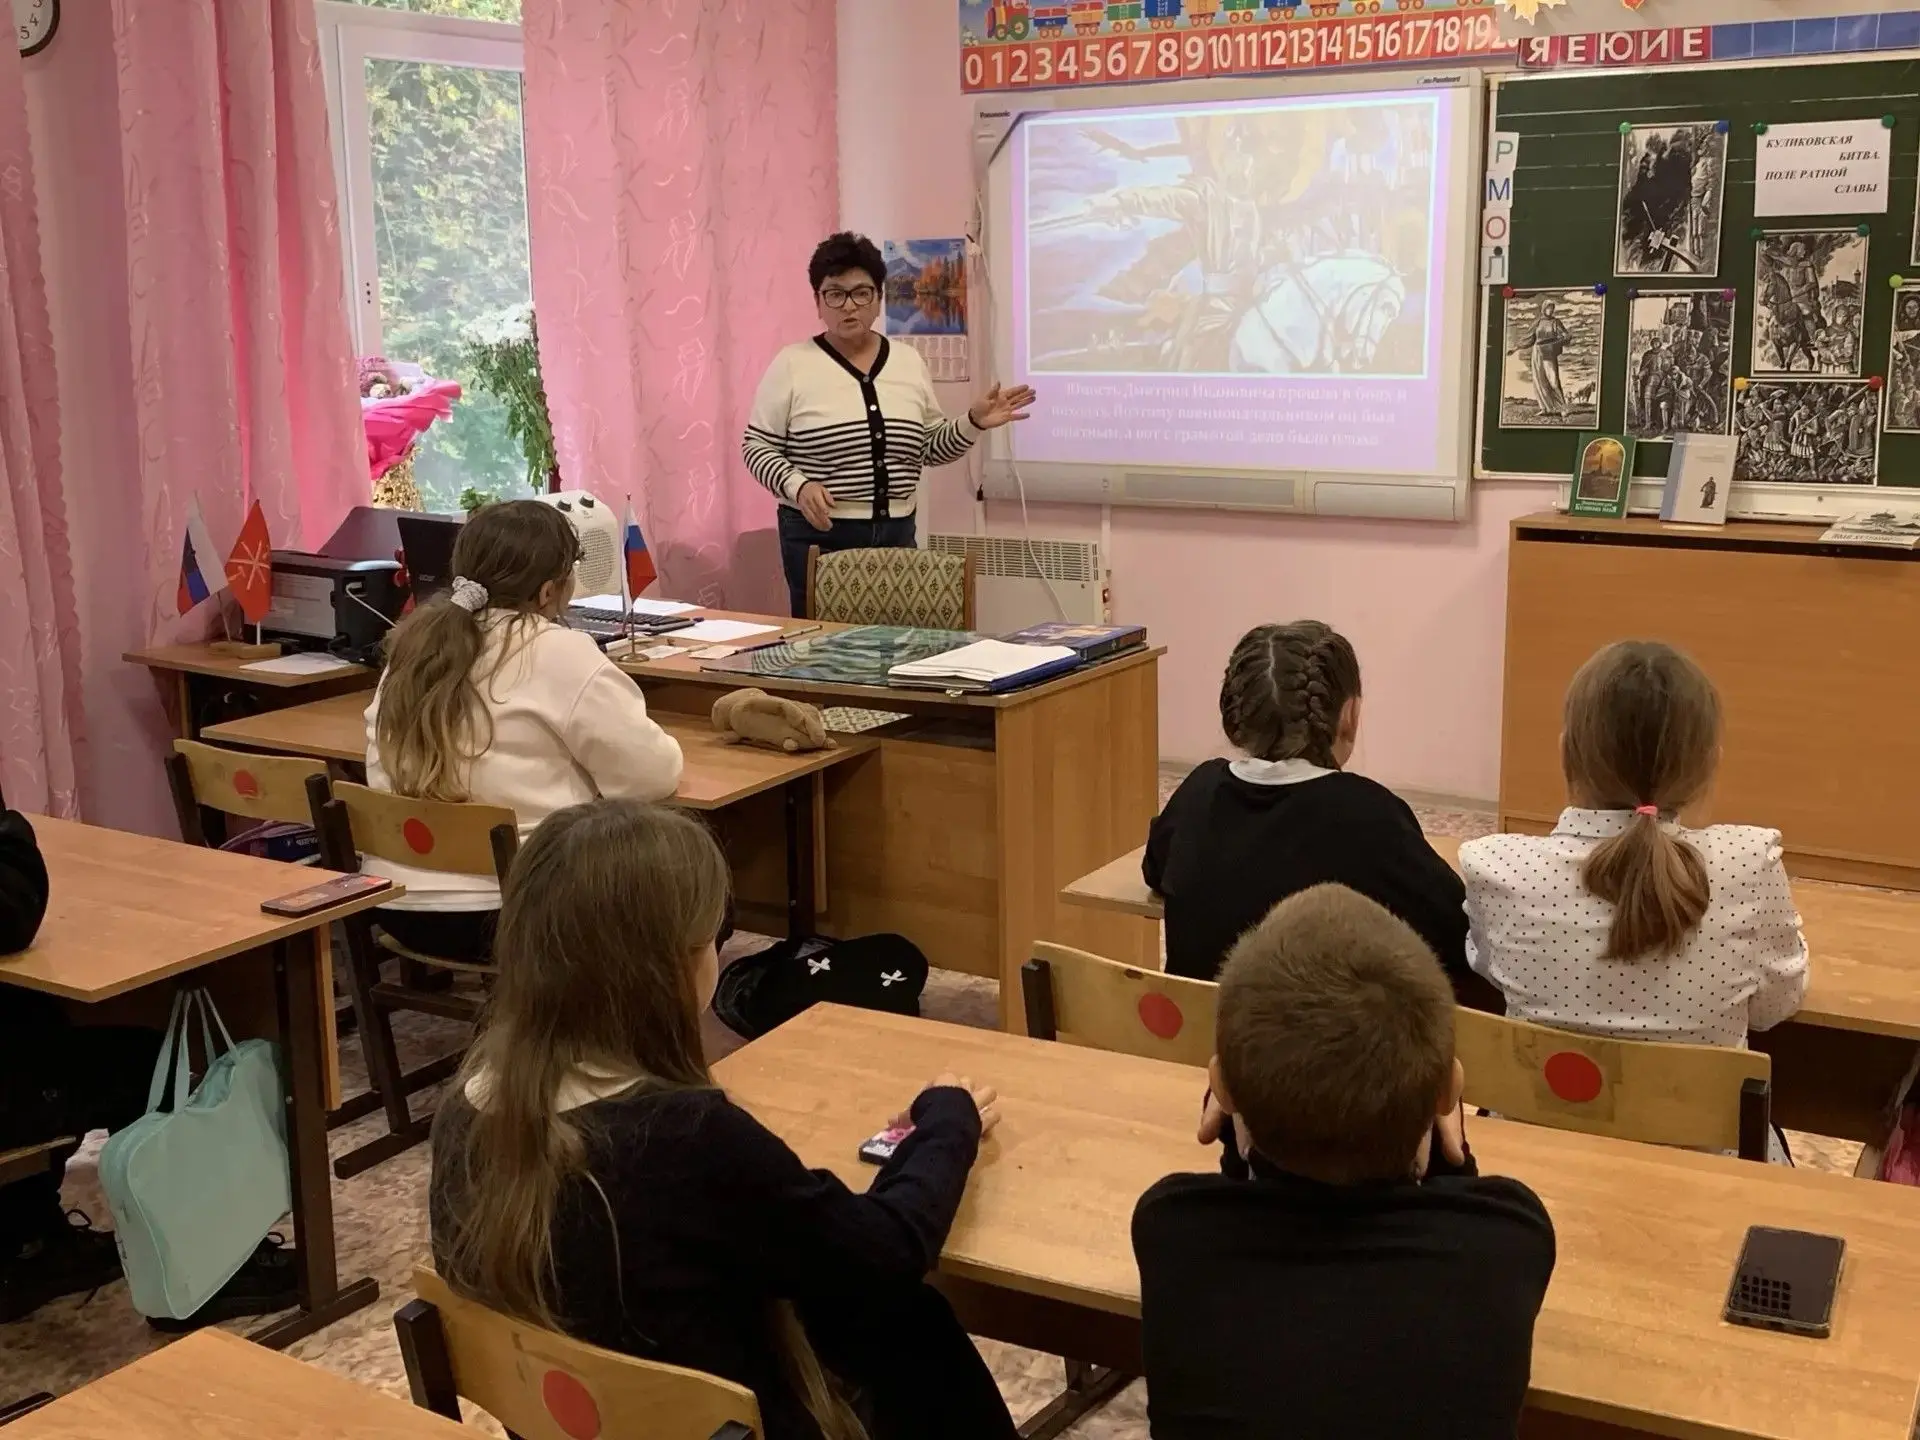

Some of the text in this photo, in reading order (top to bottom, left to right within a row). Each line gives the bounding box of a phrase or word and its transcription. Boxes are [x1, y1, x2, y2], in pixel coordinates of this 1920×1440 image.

[29, 13, 39, 26] 4
[20, 26, 30, 40] 5
[965, 14, 1492, 85] 0 1 2 3 4 5 6 7 8 9 10 11 12 13 14 15 16 17 18 19
[1526, 35, 1551, 63] Я
[1567, 35, 1587, 62] Е
[1600, 31, 1634, 61] Ю
[1641, 29, 1669, 60] И
[1683, 28, 1703, 57] Е
[979, 110, 1011, 119] Panasonic
[1765, 135, 1854, 149] КУЛИКОВСКАЯ
[1764, 166, 1848, 181] ПОЛЕ РАТНОЙ
[1834, 183, 1879, 195] СЛАВЫ
